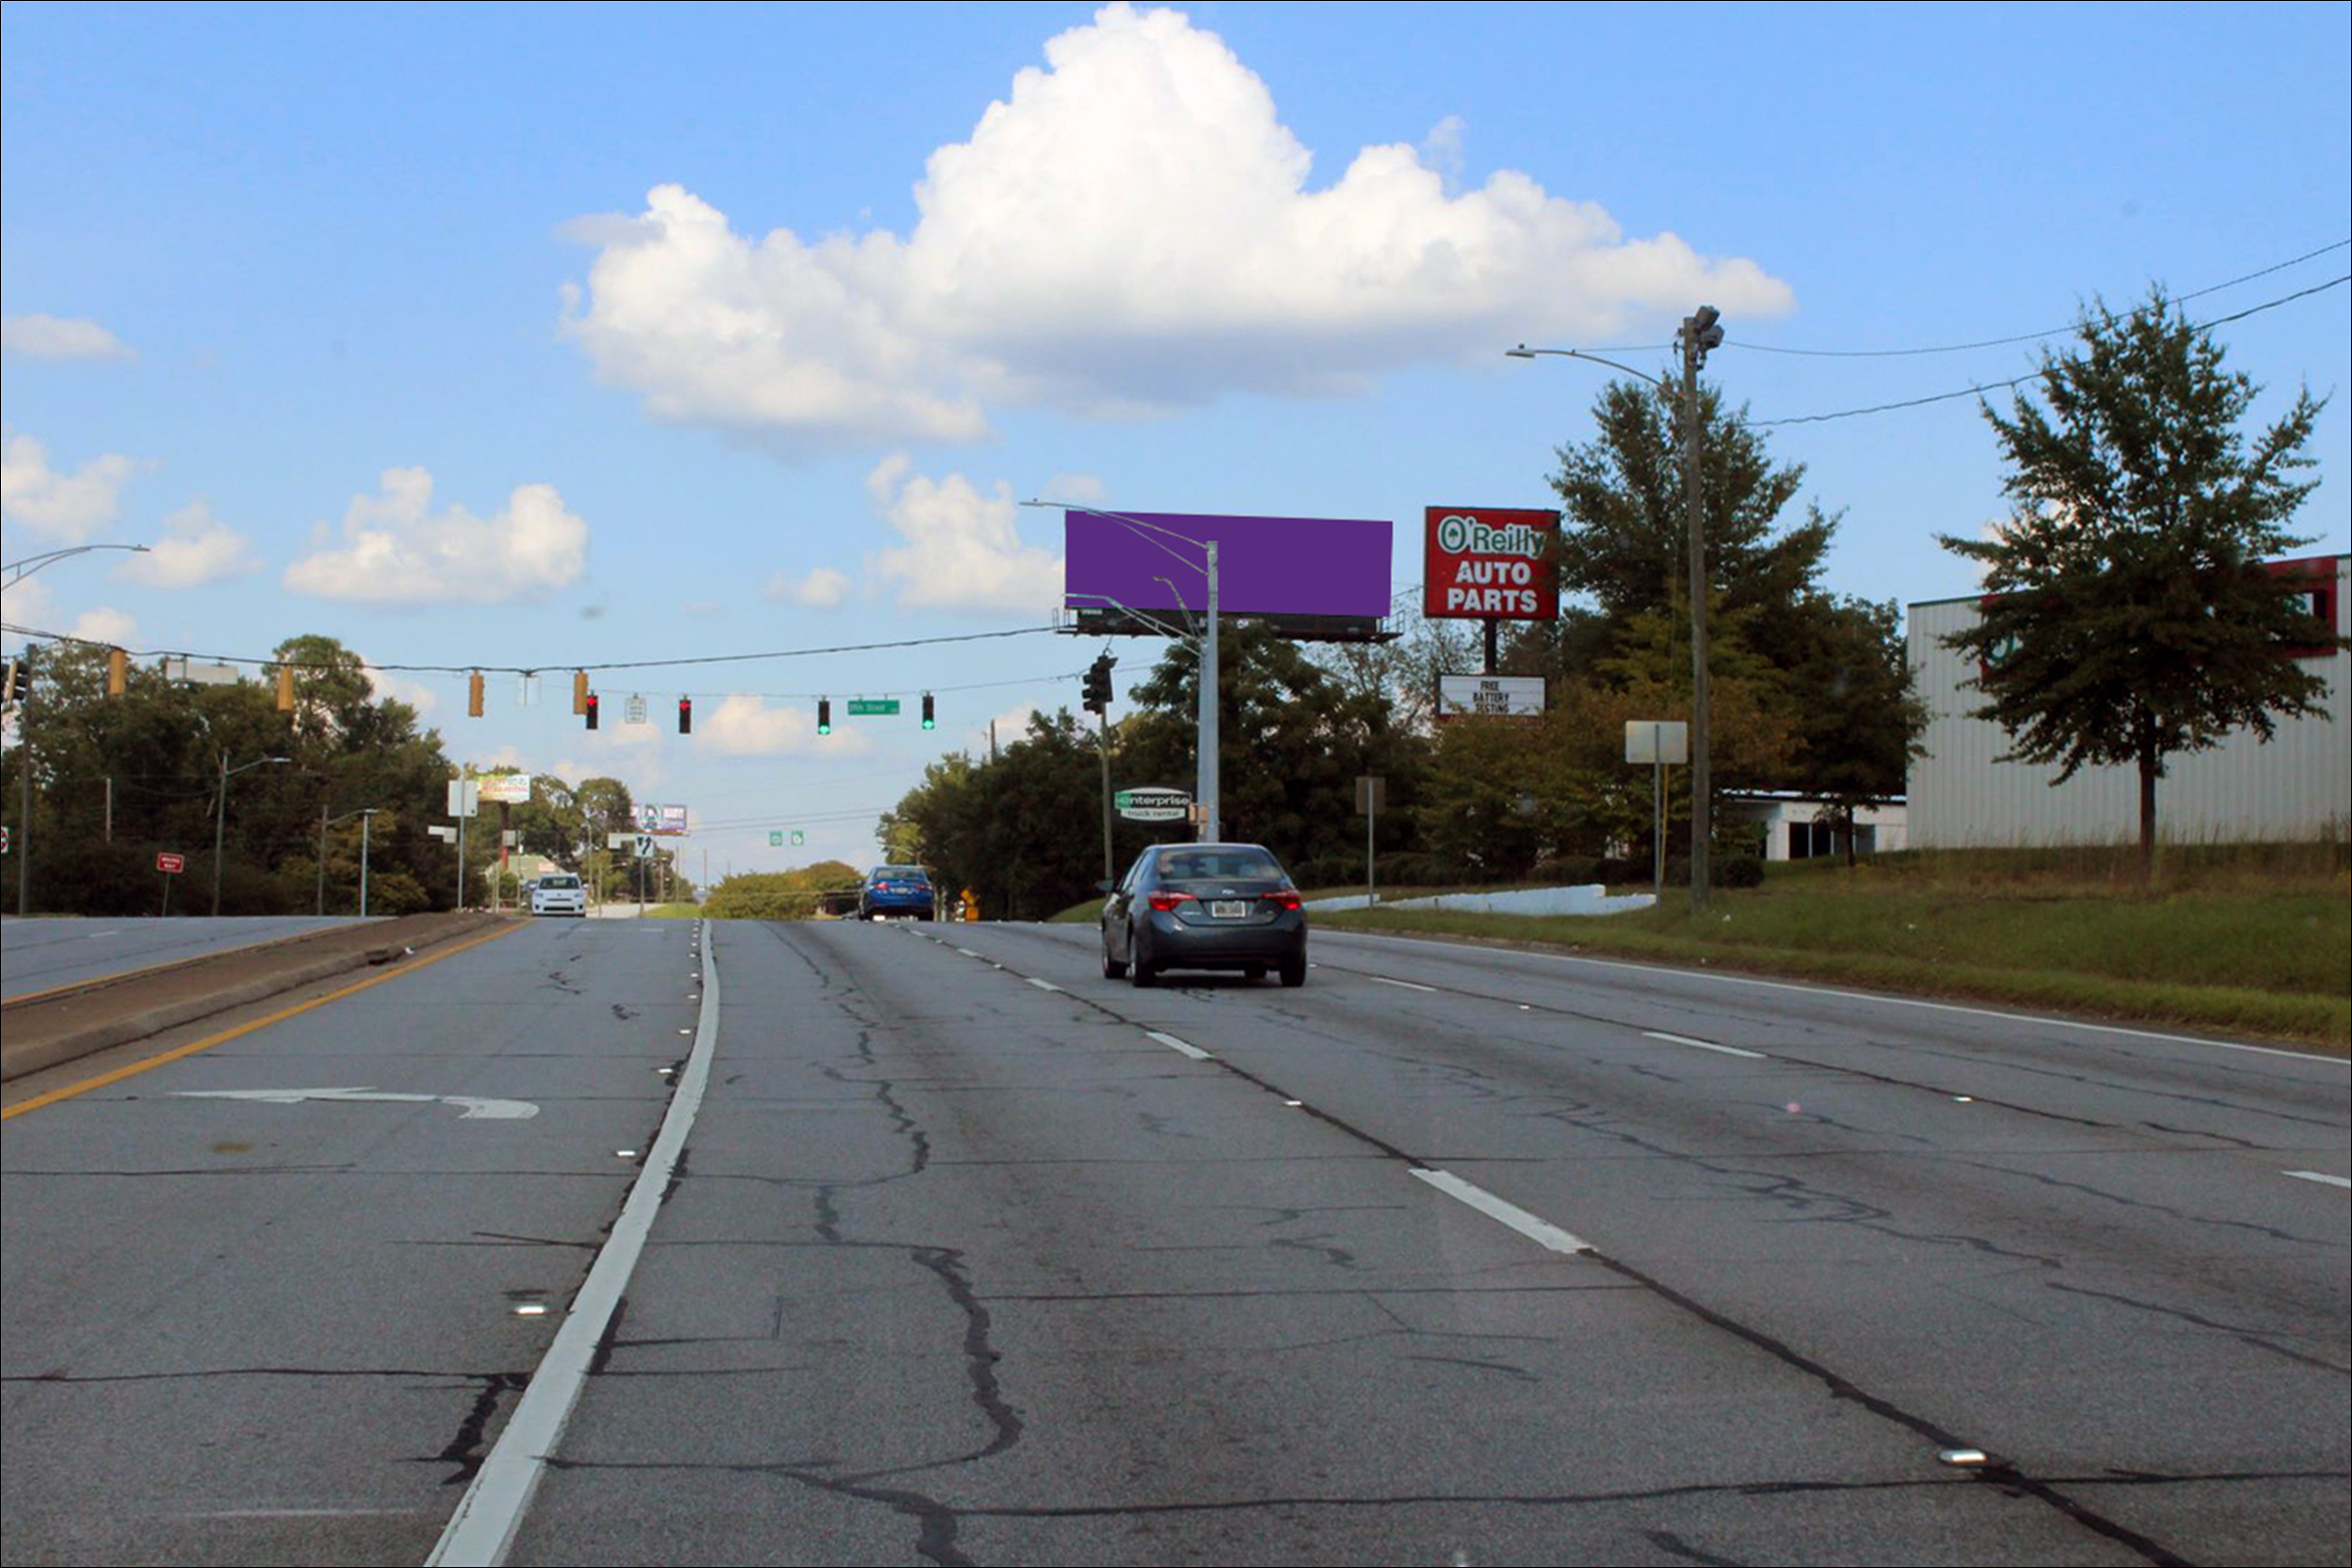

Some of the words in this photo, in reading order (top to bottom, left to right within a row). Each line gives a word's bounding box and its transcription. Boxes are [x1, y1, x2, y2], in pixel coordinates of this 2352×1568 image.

[1439, 515, 1546, 559] O'Reilly
[1455, 561, 1531, 585] AUTO
[1447, 588, 1538, 612] PARTS
[1480, 680, 1499, 691] FREE
[1473, 692, 1509, 703] BATTERY
[1475, 703, 1509, 714] TESTING
